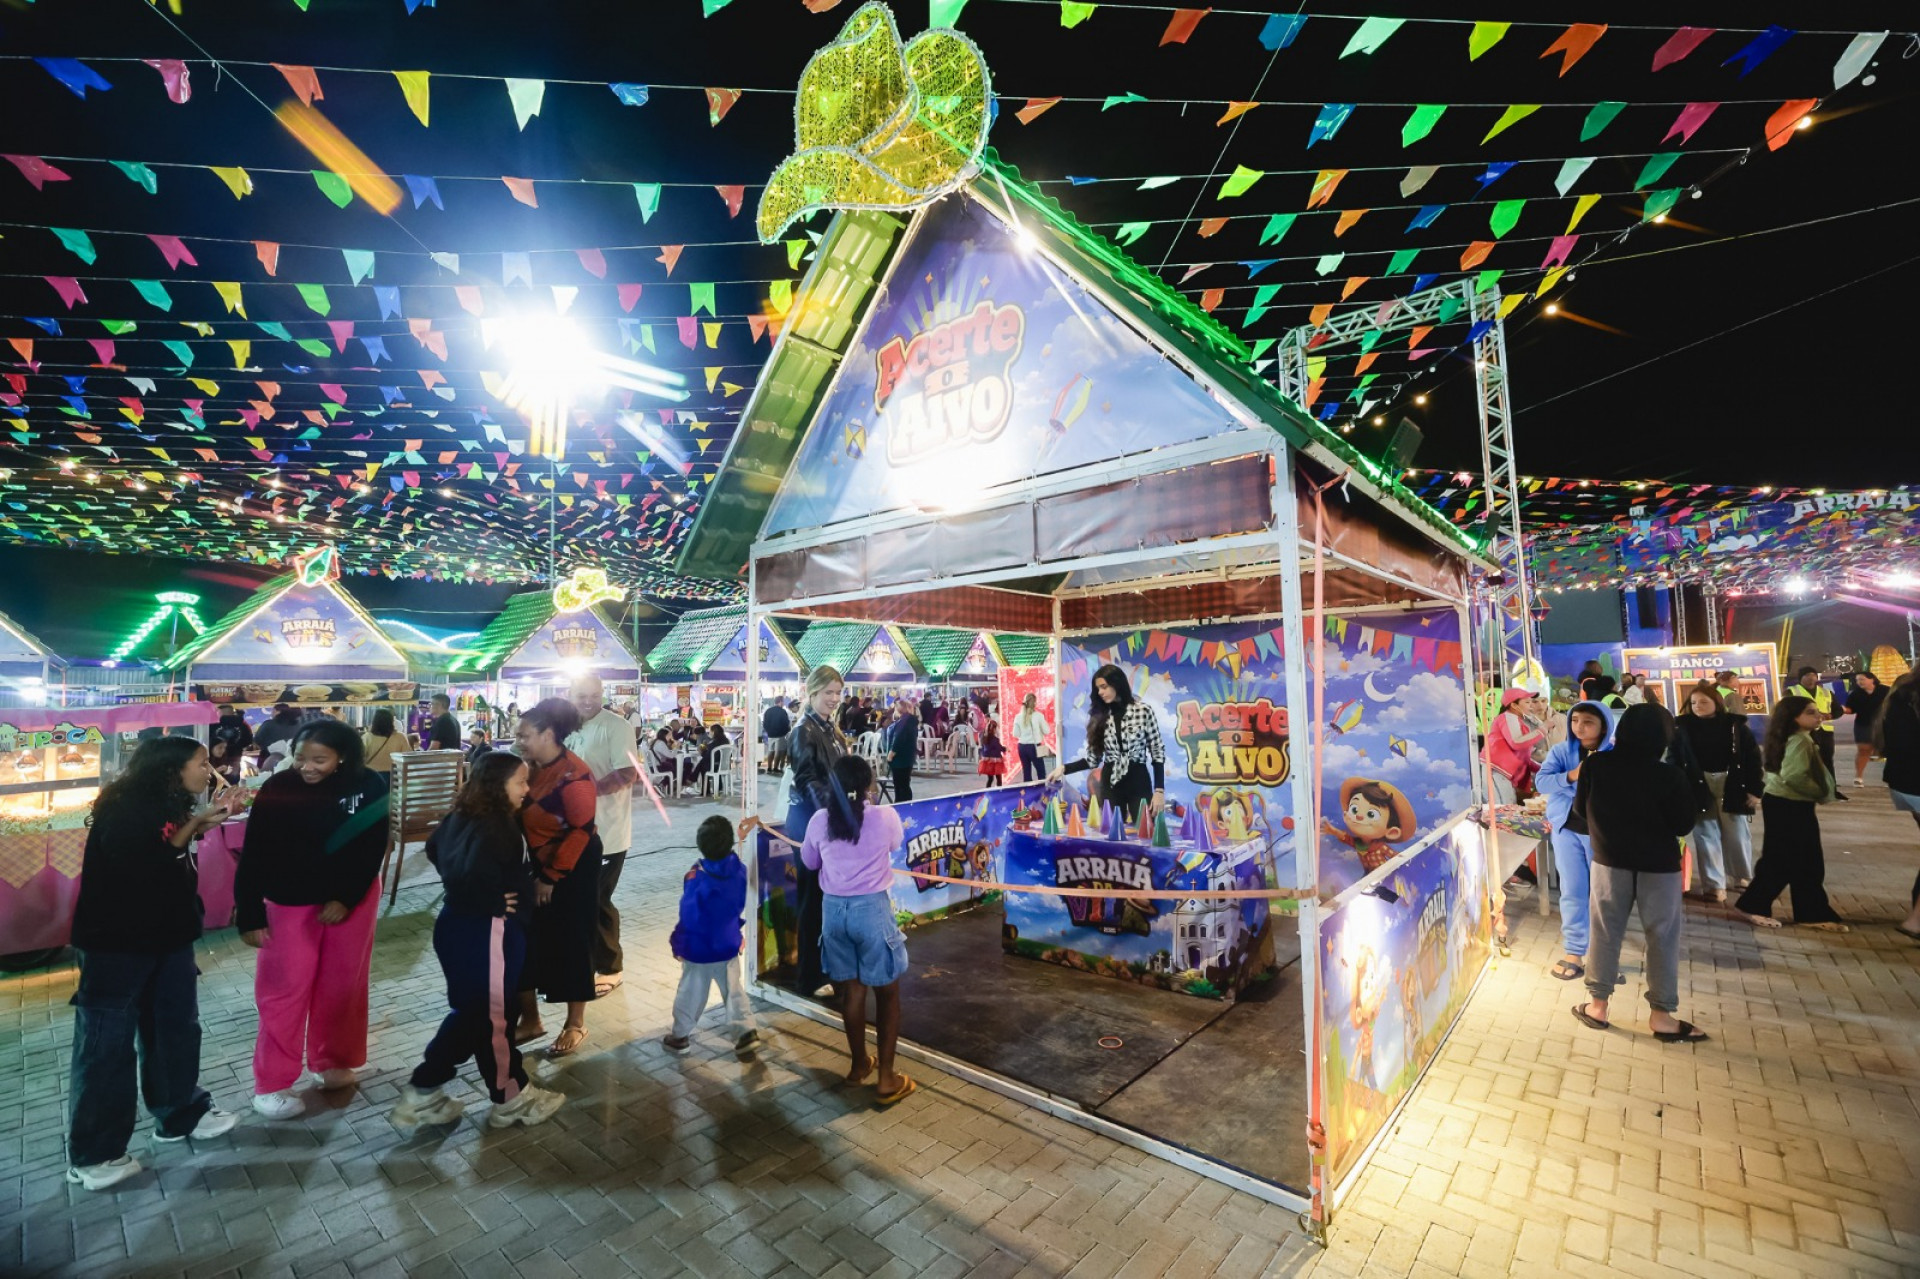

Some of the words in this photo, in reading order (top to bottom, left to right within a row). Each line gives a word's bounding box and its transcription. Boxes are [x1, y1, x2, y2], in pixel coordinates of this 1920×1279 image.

[878, 304, 1020, 399] Acerte
[1670, 657, 1724, 668] BANCO
[1179, 701, 1289, 737] Acerte
[13, 727, 105, 748] PIPOCA
[907, 819, 967, 864] ARRAIÁ
[931, 847, 945, 860] DA
[1057, 857, 1154, 890] ARRAIÁ
